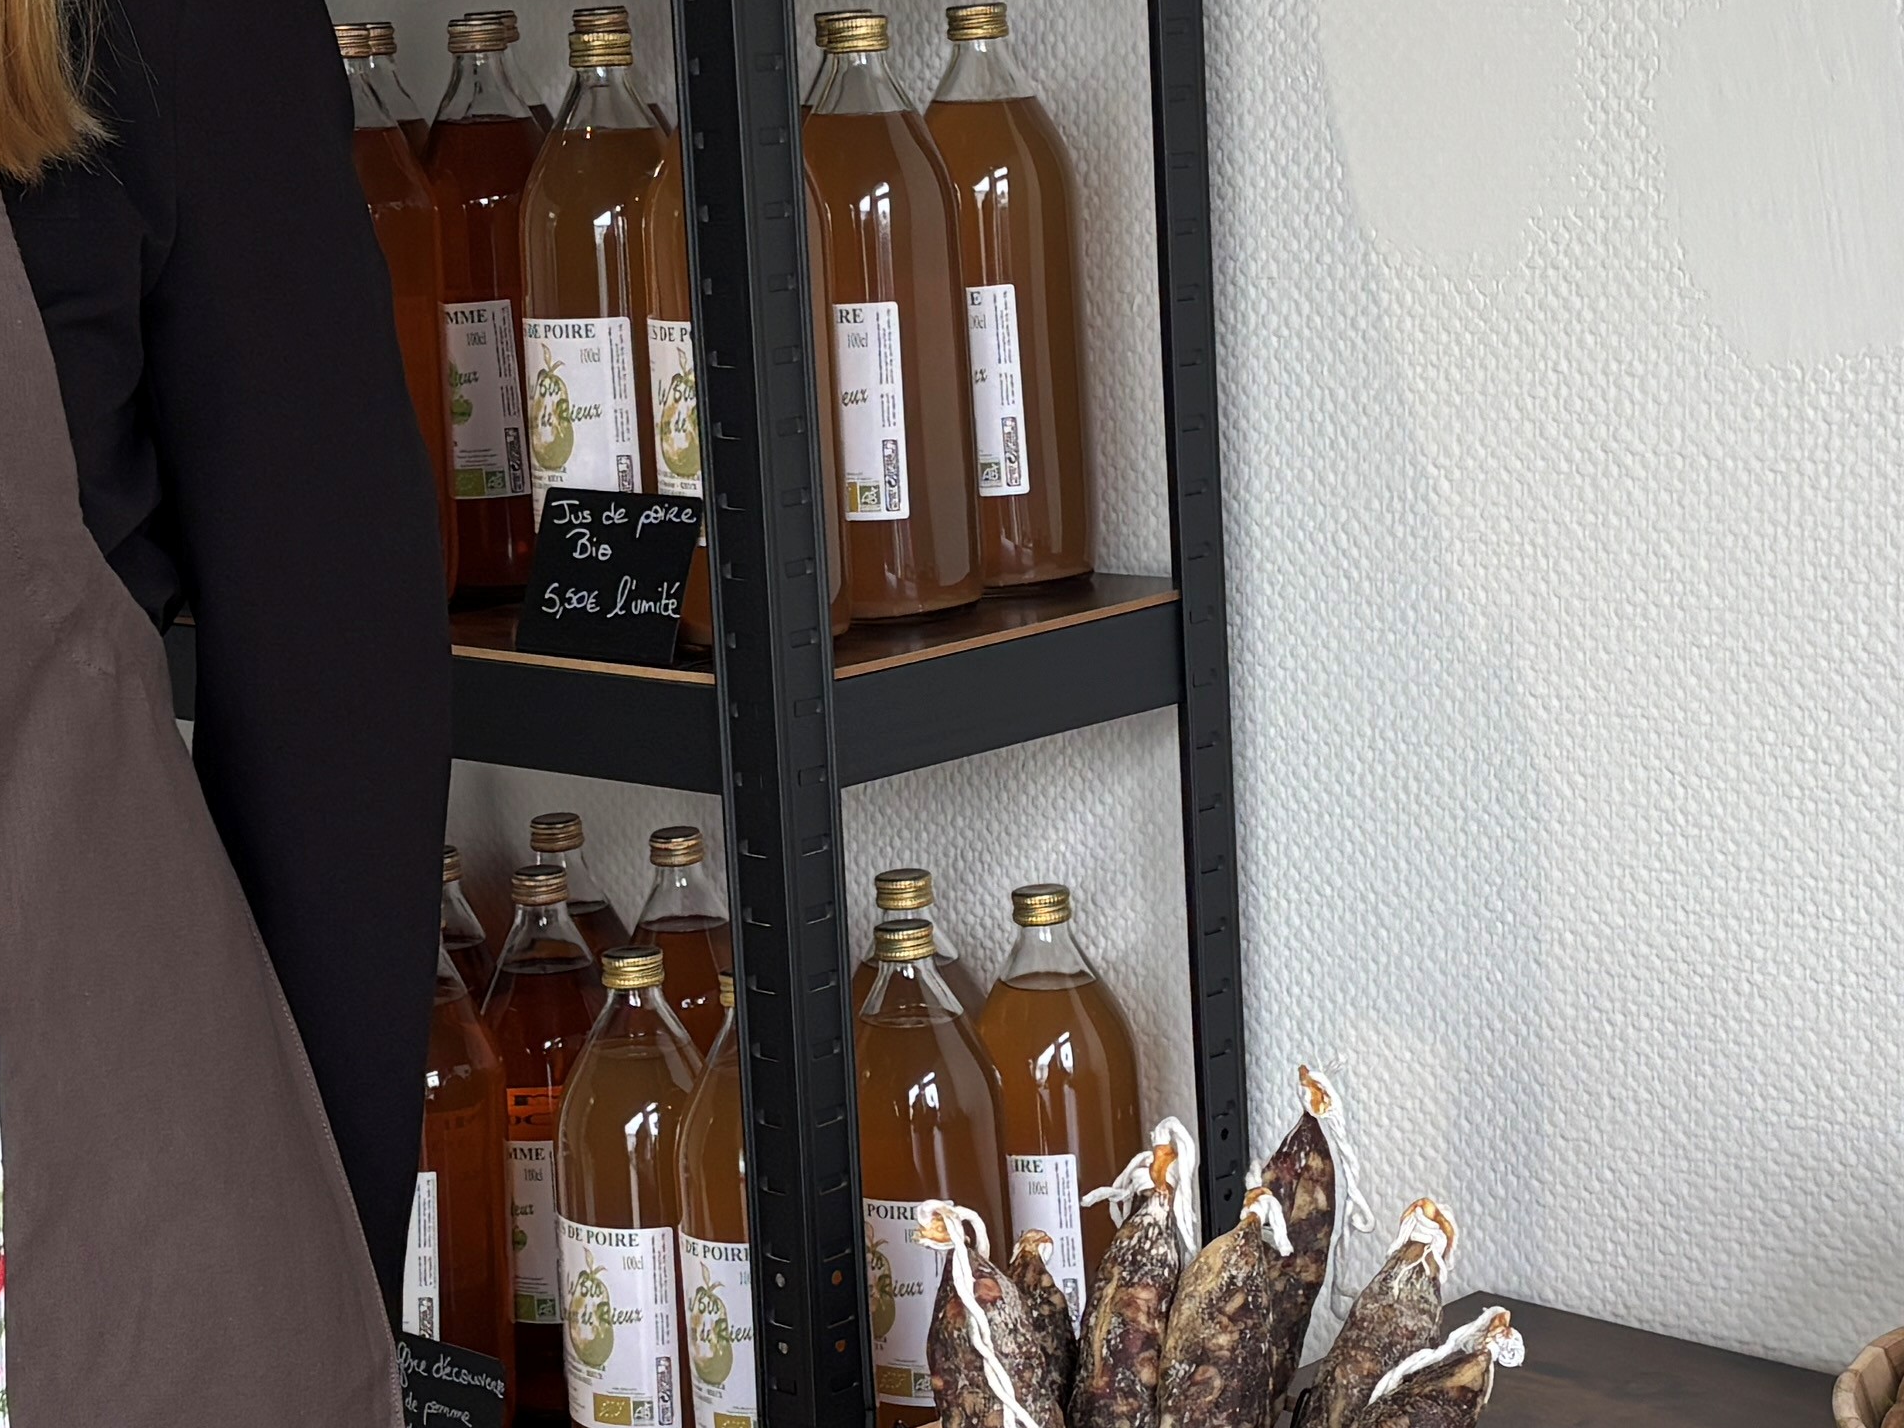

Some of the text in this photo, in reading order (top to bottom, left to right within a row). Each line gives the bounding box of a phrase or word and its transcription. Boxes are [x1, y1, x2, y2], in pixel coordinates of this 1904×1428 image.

[446, 309, 487, 325] MME
[544, 323, 596, 340] POIRE
[660, 327, 676, 342] DE
[847, 333, 868, 349] 100cl
[580, 347, 601, 364] 100cl
[842, 388, 867, 407] eux
[552, 500, 697, 539] Jus de poire
[566, 528, 613, 562] Bio
[542, 583, 600, 619] 5,50€
[509, 1147, 545, 1162] MME
[1014, 1159, 1043, 1174] IRE
[568, 1227, 583, 1243] DE
[586, 1231, 640, 1248] POIRE
[686, 1243, 750, 1263] DE POIR
[622, 1255, 644, 1272] 100cl
[597, 1301, 644, 1326] Rieux
[714, 1317, 753, 1342] Rieu
[405, 1392, 472, 1428] de pomme
